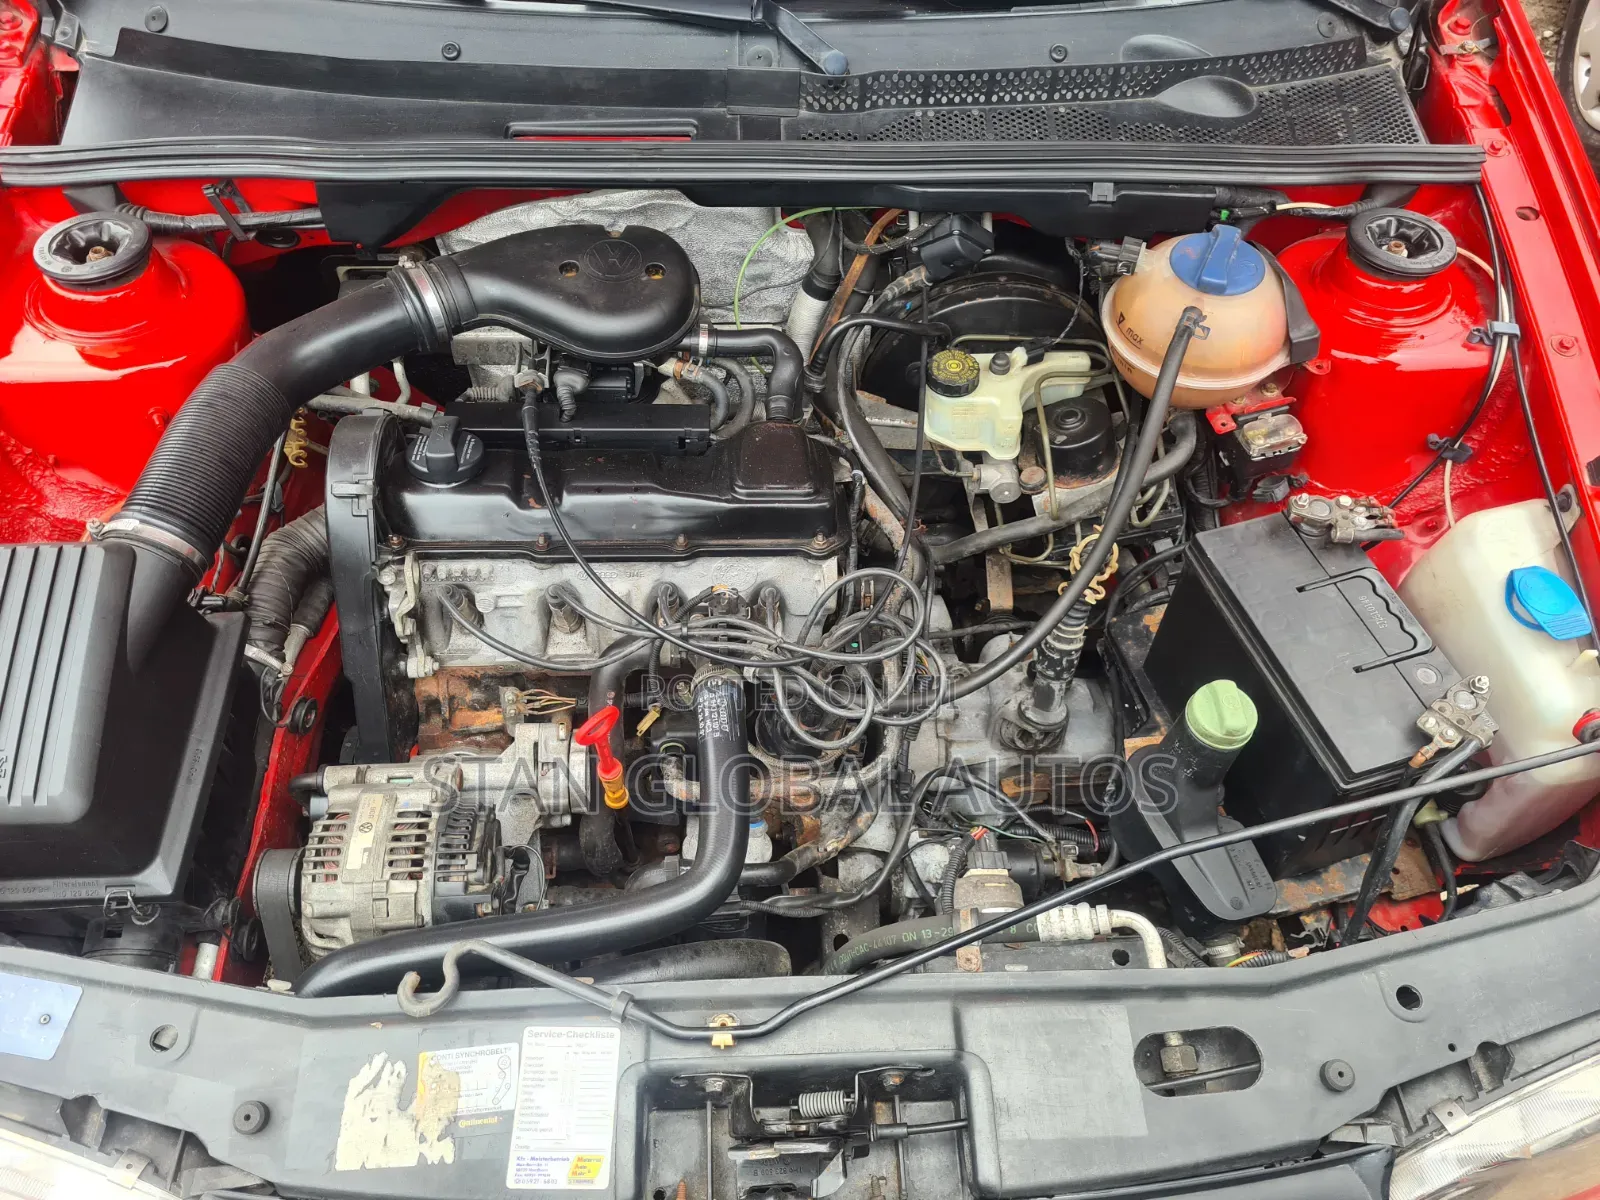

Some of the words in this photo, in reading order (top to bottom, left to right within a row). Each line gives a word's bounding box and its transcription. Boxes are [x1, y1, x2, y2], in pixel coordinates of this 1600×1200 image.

[1126, 327, 1144, 345] max
[1117, 358, 1133, 374] min
[527, 1029, 616, 1039] Service-Checkliste
[458, 1115, 499, 1128] Continental
